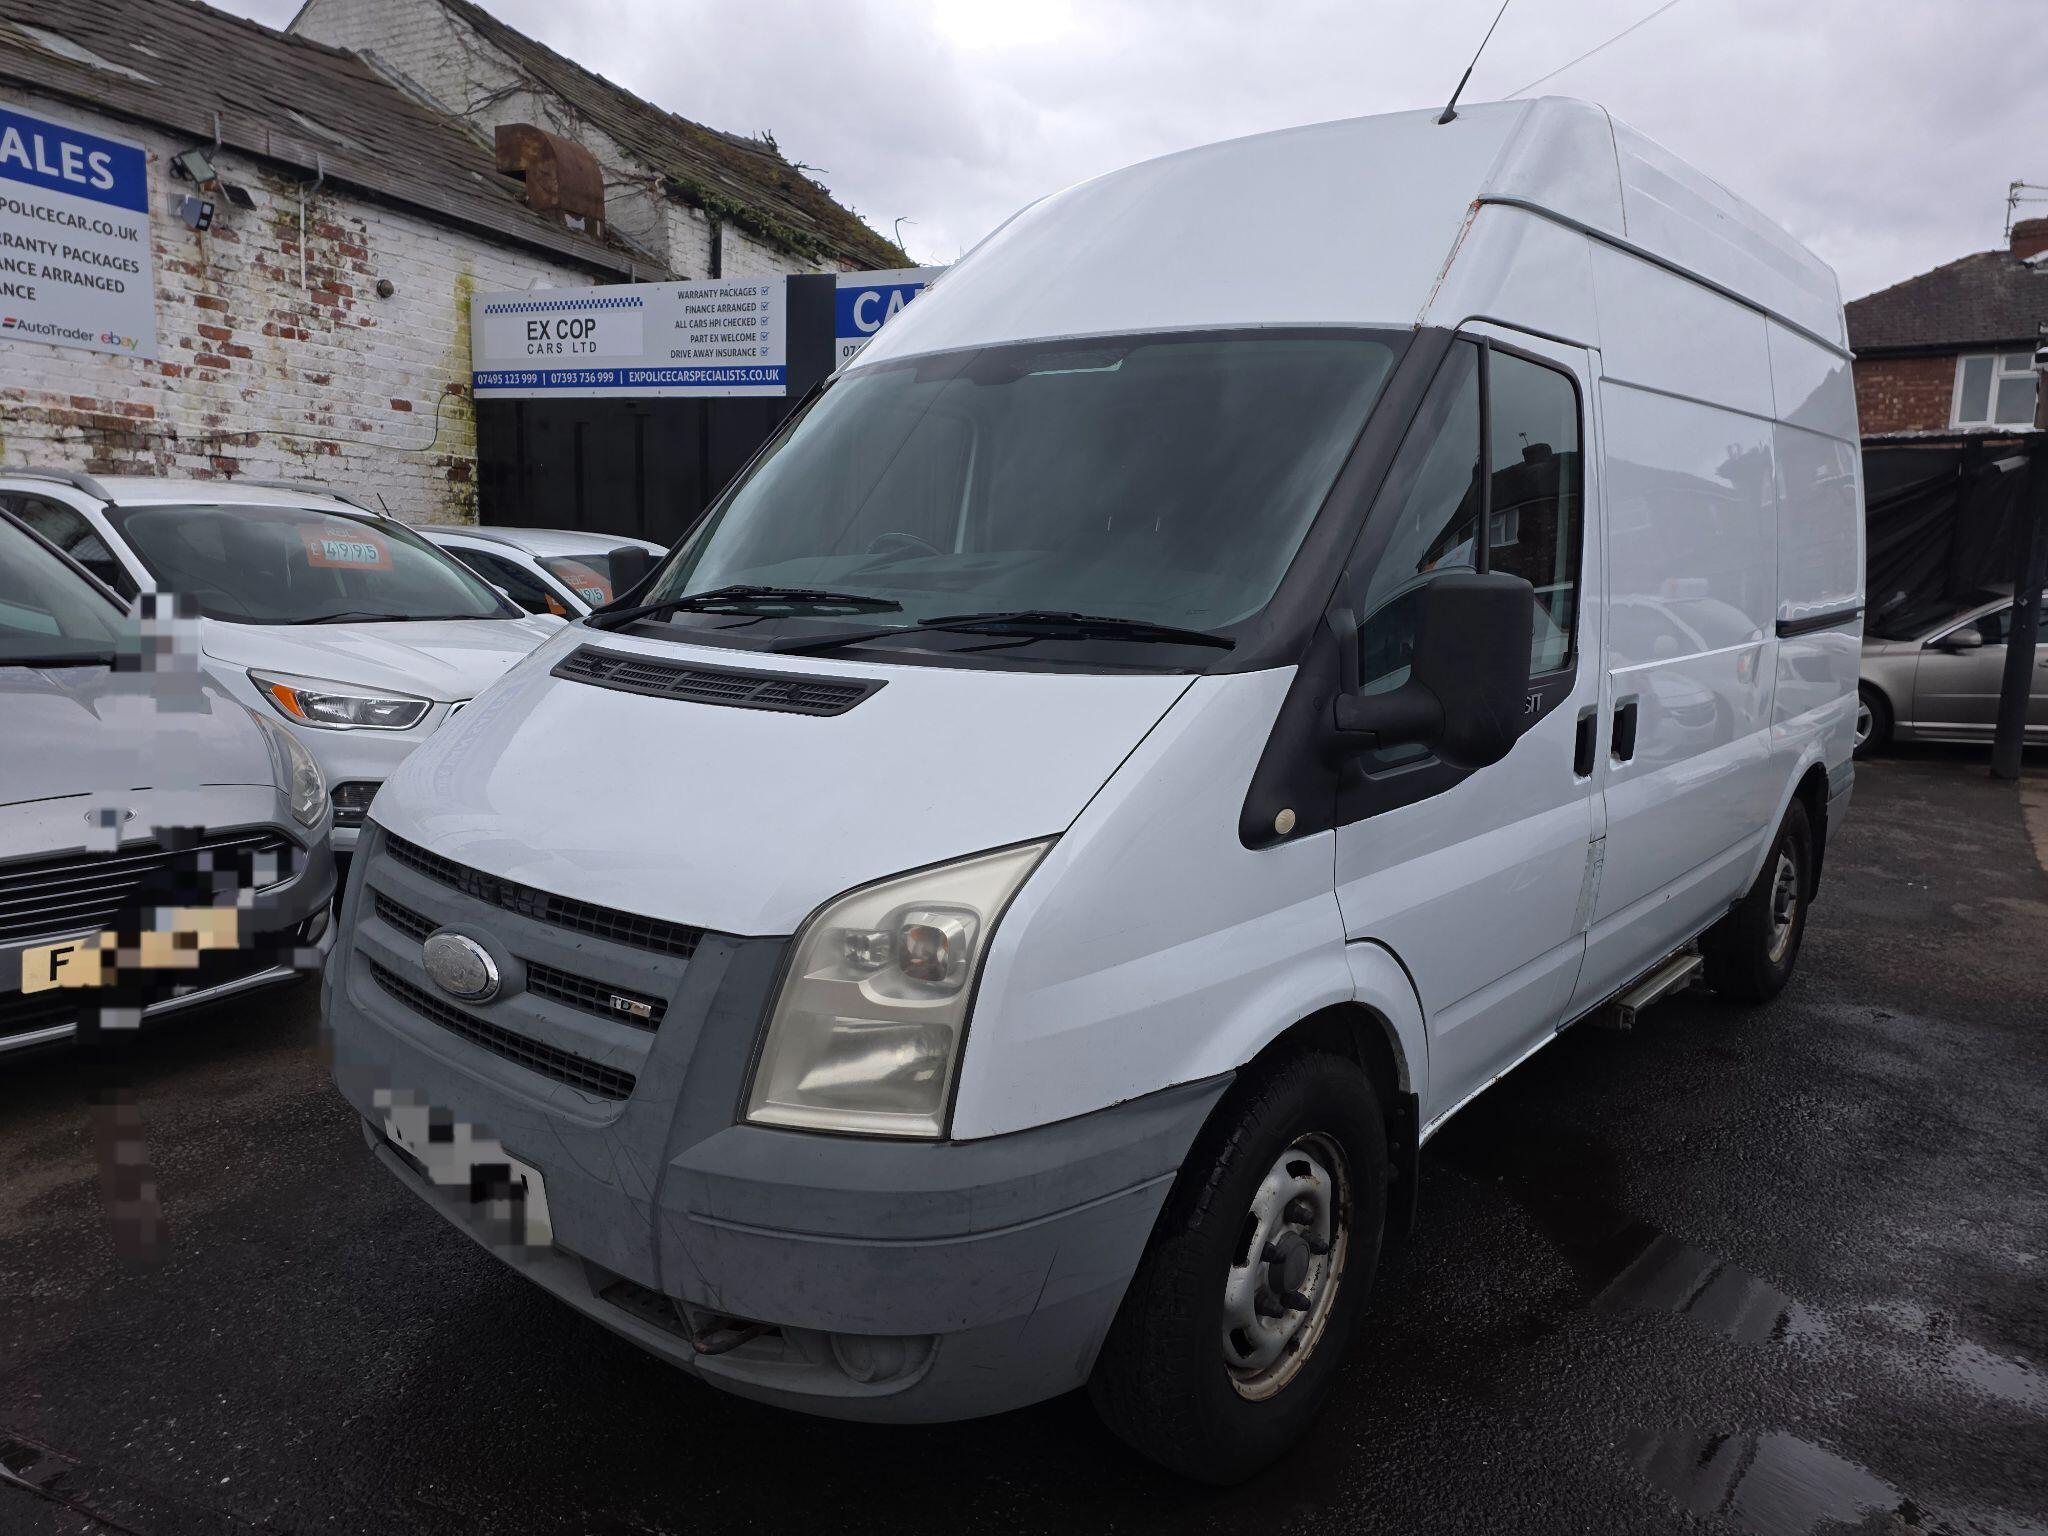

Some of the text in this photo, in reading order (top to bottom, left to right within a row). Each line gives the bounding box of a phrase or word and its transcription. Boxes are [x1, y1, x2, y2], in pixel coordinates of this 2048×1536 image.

[0, 232, 140, 274] RANTY PACKAGES
[41, 265, 125, 293] ARRANGED
[0, 282, 36, 301] NCE
[677, 287, 757, 300] WARRANTY PACKAGES
[685, 302, 757, 314] FINANCE ARRANGED
[853, 289, 924, 332] CA
[17, 319, 95, 341] AutoTrader
[527, 318, 596, 340] EX COP
[675, 317, 757, 329] ALL CARS HPI CHECKED
[101, 331, 138, 351] ebay
[690, 332, 757, 343] PART EX WELCOME
[527, 341, 597, 355] CARS LTD
[671, 347, 757, 358] DRIVE AWAY INSURANCE
[842, 345, 861, 357] 07
[477, 368, 780, 385] 07495 123 999 07393 736 999 EXPOLICECARSPECIALISTS.CO.UK
